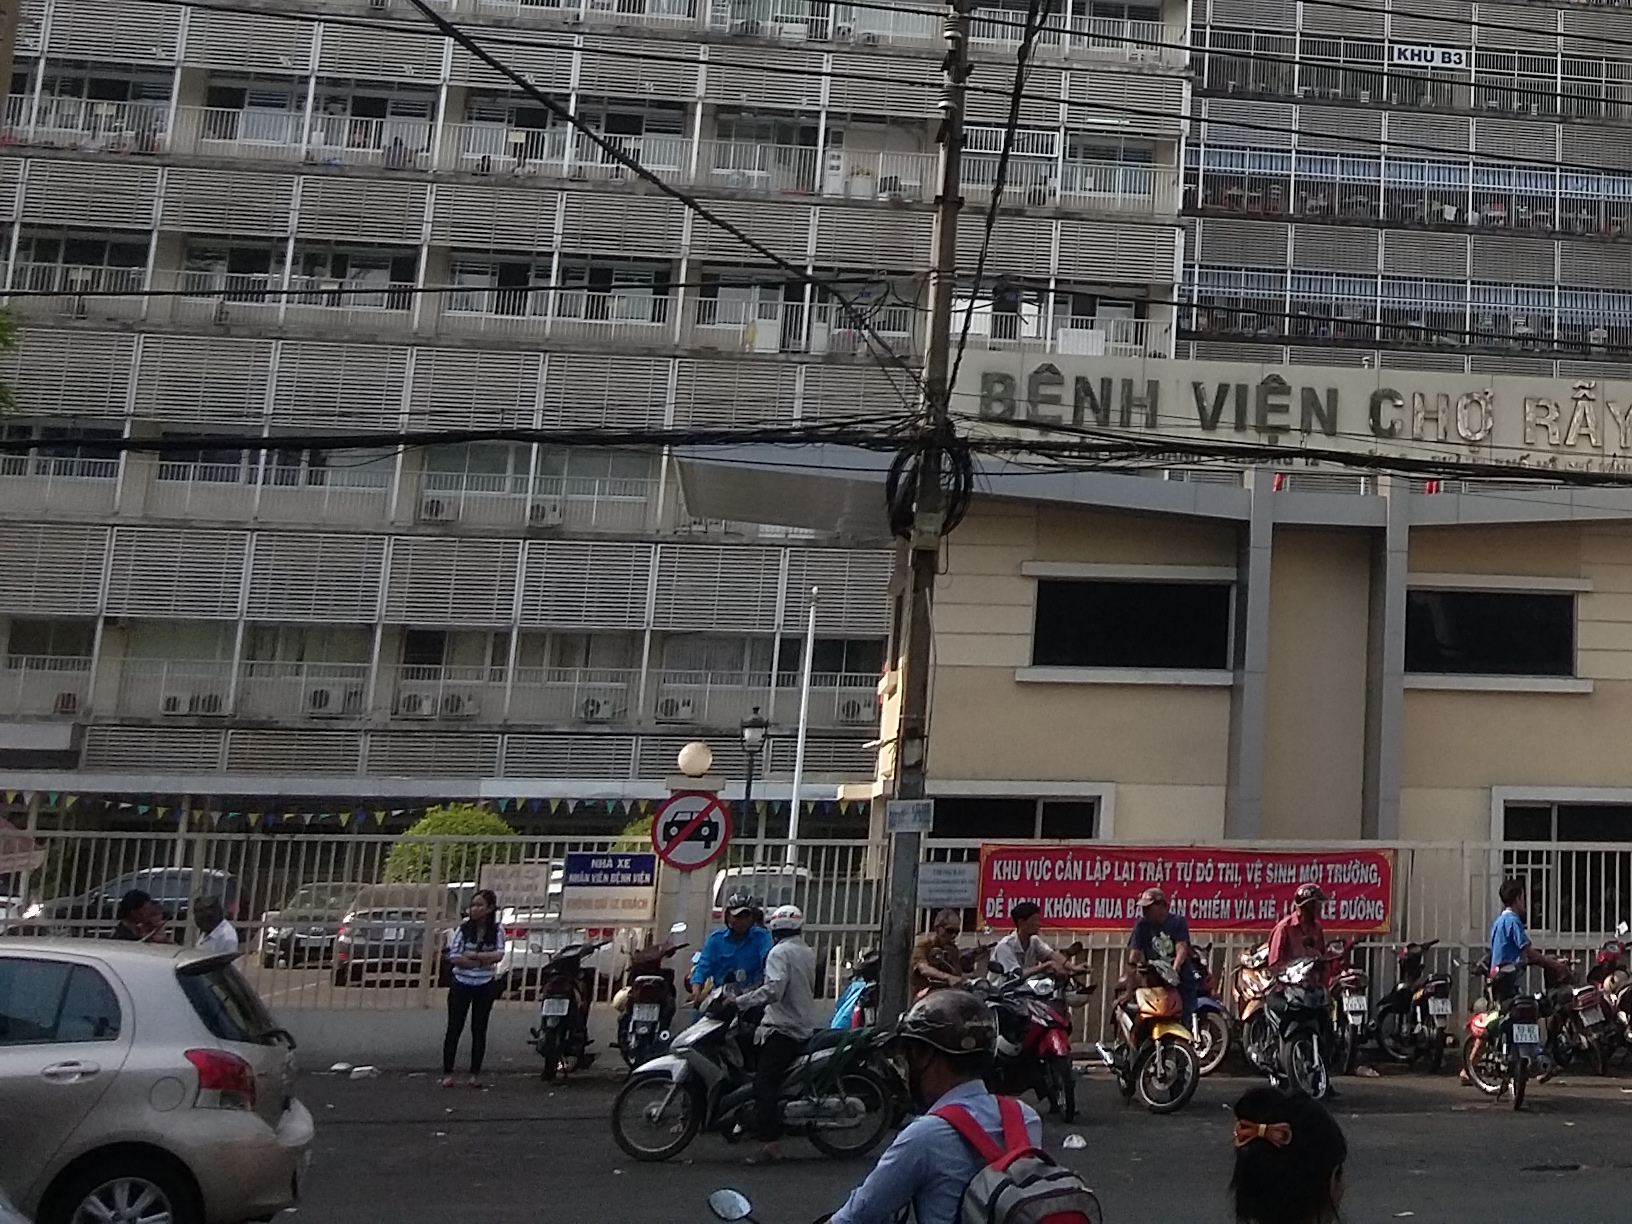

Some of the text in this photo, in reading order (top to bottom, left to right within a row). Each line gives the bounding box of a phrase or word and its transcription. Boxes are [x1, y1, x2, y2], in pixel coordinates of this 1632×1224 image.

[1397, 47, 1463, 65] KHU B3
[979, 362, 1160, 436] BỆNH
[1191, 373, 1339, 445] VIỆN
[1368, 387, 1494, 453] CHỢ
[591, 855, 632, 869] NHÀ XE
[993, 859, 1022, 881] KHU
[1025, 856, 1052, 886] VỰC
[1086, 856, 1111, 887] LẬP
[1114, 860, 1136, 887] LẠI
[1138, 857, 1173, 888] TRẬT
[1176, 859, 1195, 888] TỰ
[1196, 858, 1214, 883] ĐÔ
[1217, 863, 1242, 889] THỊ,
[1246, 859, 1263, 889] VỆ
[1265, 862, 1296, 883] SINH
[1299, 859, 1323, 884] MÔI
[1327, 859, 1381, 888] TRƯỜNG,
[1043, 893, 1091, 919] KHÔNG
[1094, 897, 1123, 919] MUA
[1189, 890, 1231, 920] CHIẾM
[1339, 893, 1385, 921] ĐƯỜNG
